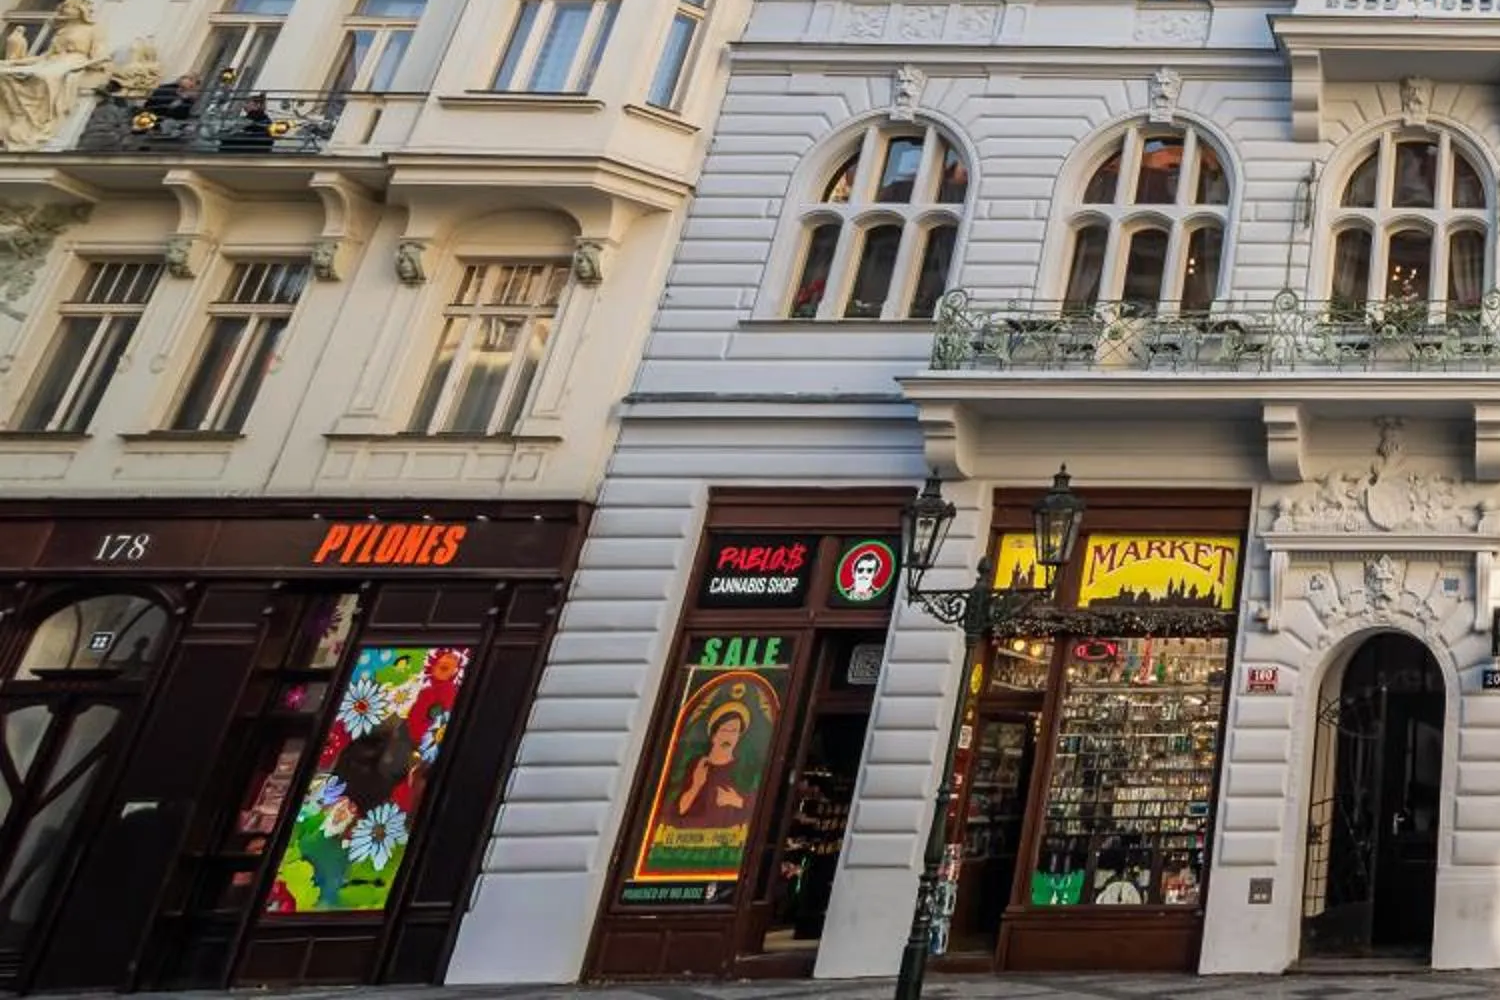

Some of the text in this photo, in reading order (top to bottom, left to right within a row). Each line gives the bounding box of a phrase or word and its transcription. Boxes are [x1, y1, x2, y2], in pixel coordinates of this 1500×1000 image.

[93, 533, 152, 561] 178
[312, 521, 468, 566] PYLONES
[1088, 539, 1236, 585] MARKET
[709, 577, 800, 594] CANNABIS SHOP
[701, 636, 782, 667] SALE
[1485, 673, 1500, 686] 20
